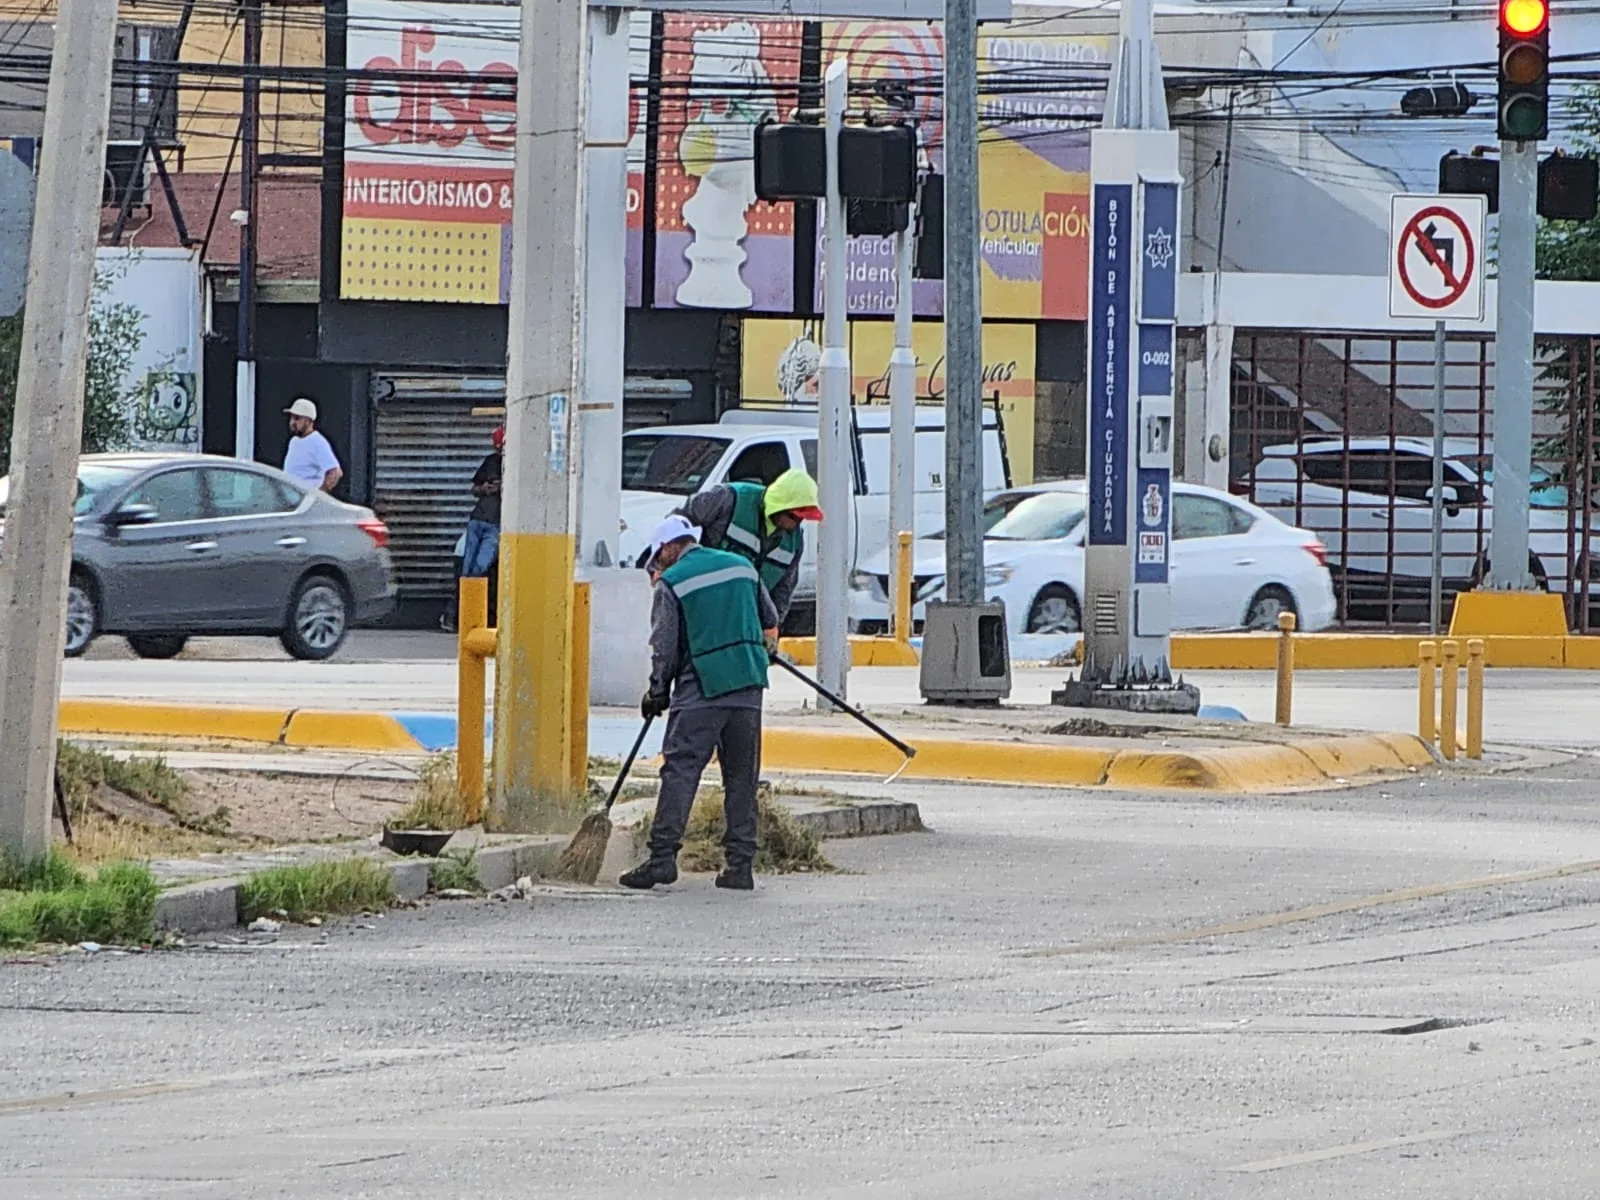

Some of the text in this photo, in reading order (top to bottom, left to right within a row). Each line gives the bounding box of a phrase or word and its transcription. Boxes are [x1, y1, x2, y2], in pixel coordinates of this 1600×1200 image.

[982, 98, 1098, 129] LUMINOSOS
[346, 177, 512, 208] INTERIORISMO &
[980, 206, 1090, 238] OTULACIÓN
[1107, 271, 1116, 294] DE
[1105, 304, 1115, 419] ASISTENCIA
[1104, 429, 1113, 533] CIUDADANA
